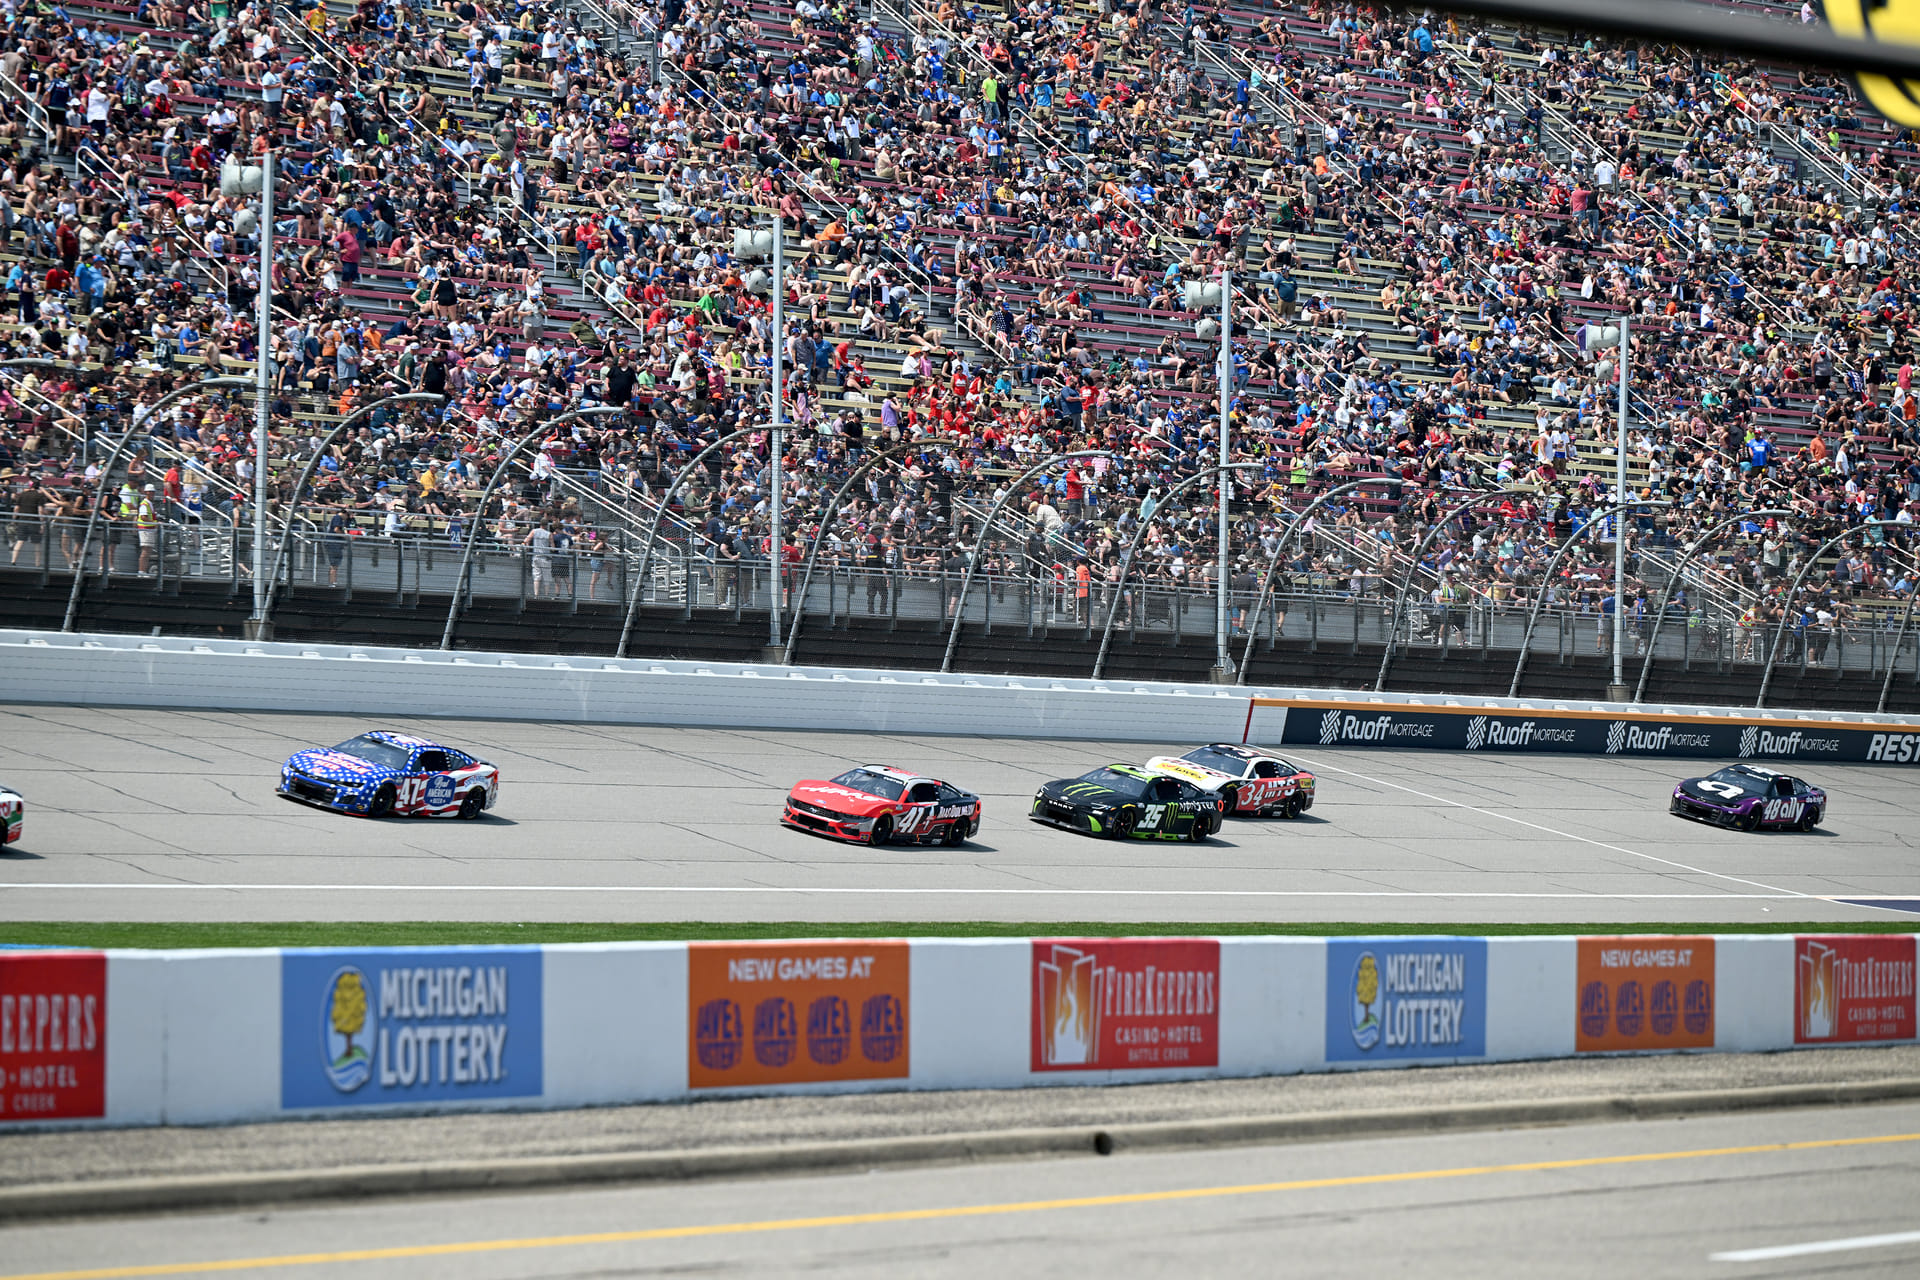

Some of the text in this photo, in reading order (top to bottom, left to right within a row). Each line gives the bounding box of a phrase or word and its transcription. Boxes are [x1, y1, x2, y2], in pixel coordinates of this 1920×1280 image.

[1342, 716, 1434, 740] Ruoff MORTGAGE
[1487, 721, 1575, 745] Ruoff MORTGAGE
[1626, 726, 1711, 750] Ruoff MORTGAGE
[1758, 730, 1839, 754] Ruoff MORTGAGE
[400, 778, 421, 805] 47
[1241, 783, 1265, 806] 34
[1265, 779, 1295, 799] MTS
[898, 806, 925, 833] 41
[1137, 804, 1167, 829] 35
[1764, 798, 1782, 820] 48
[1780, 796, 1805, 824] ally
[728, 956, 875, 982] NEW GAMES AT
[1601, 949, 1693, 968] NEW GAMES AT
[1386, 953, 1464, 993] MICHIGAN
[380, 966, 507, 1018] MICHIGAN
[1115, 1025, 1202, 1044] CASINO HOTEL
[1385, 999, 1463, 1046] LOTTERY
[379, 1024, 507, 1086] LOTTERY
[20, 1064, 78, 1088] HOTEL
